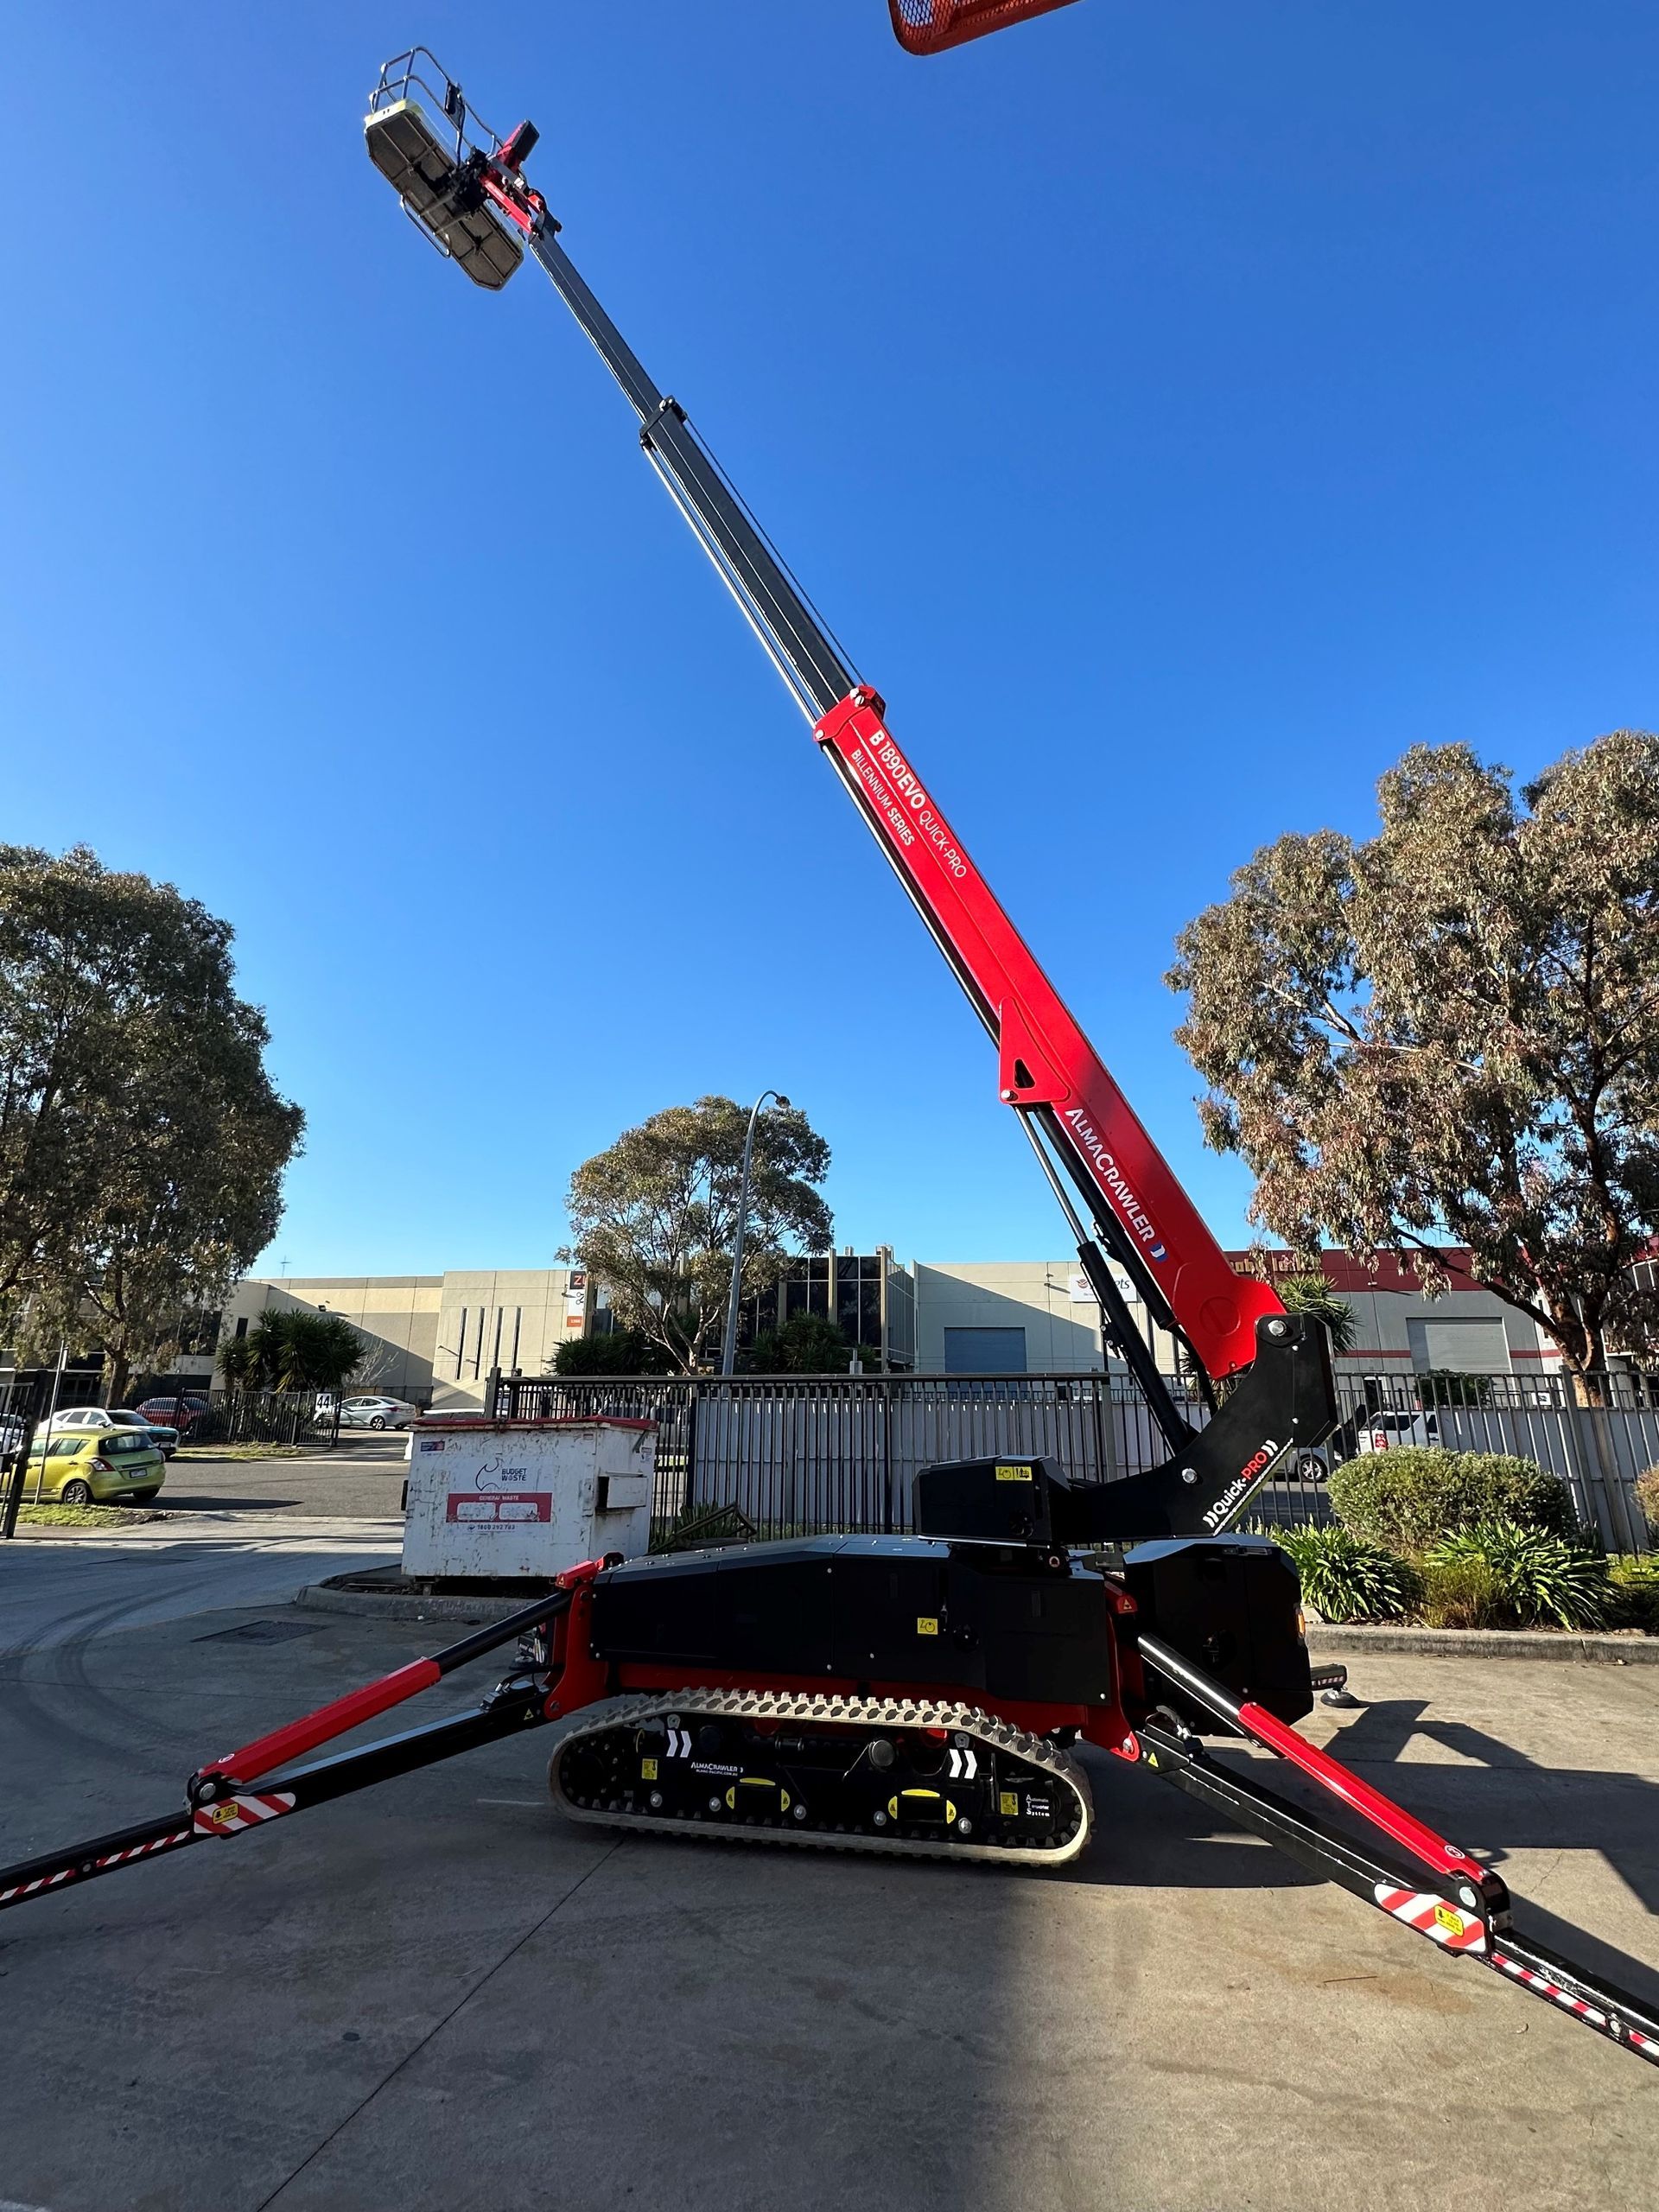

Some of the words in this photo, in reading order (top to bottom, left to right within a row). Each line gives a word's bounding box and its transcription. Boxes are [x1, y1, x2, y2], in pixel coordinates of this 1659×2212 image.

[851, 749, 893, 810] BILLENNIUM
[887, 807, 915, 846] SERIES
[869, 729, 885, 746] B
[878, 741, 926, 809] 1890EVO
[919, 810, 966, 878] QUICK-PRO
[1065, 1109, 1155, 1242] ALMACRAWLER
[317, 1395, 329, 1408] 44
[1213, 1452, 1267, 1515] Quick-PRO
